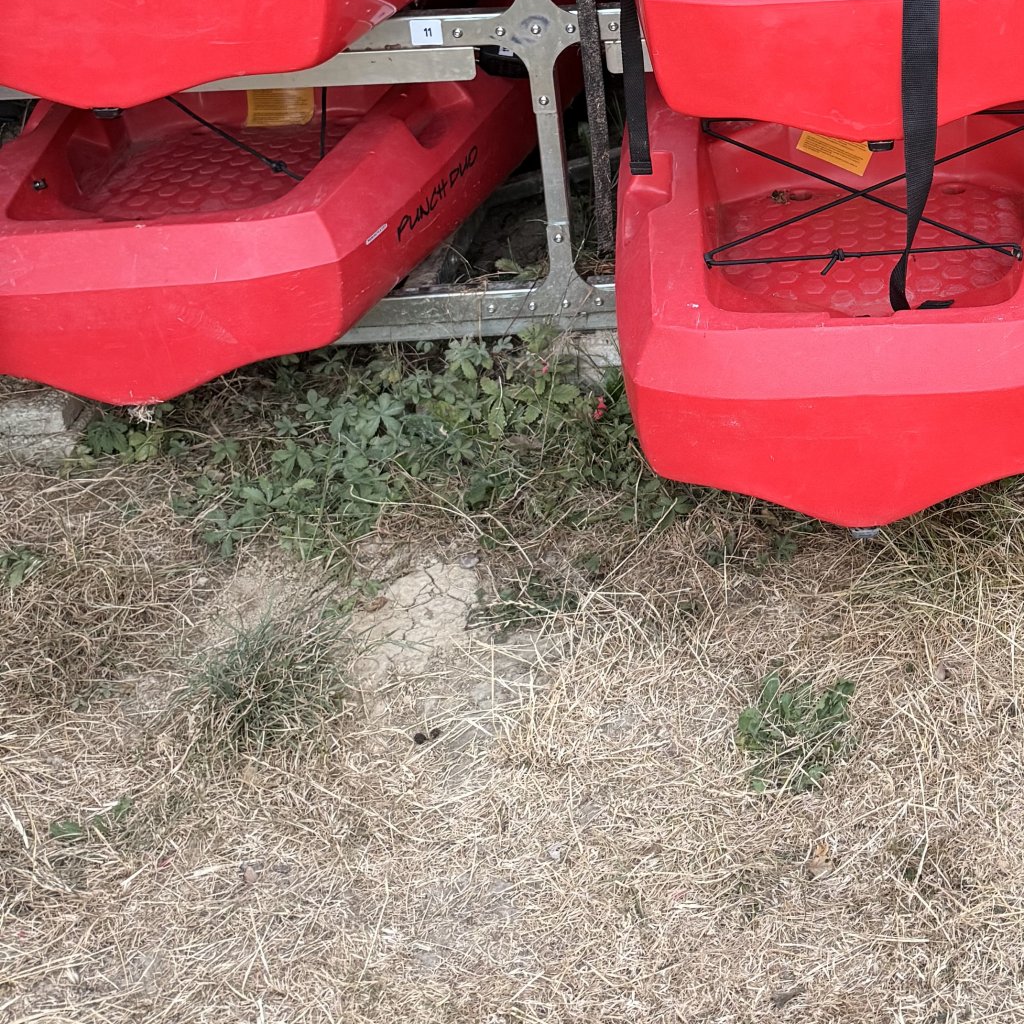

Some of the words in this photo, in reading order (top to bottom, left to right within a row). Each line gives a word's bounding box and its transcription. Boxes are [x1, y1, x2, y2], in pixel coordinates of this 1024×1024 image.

[423, 27, 433, 37] 11
[397, 179, 448, 242] PUNCH
[449, 144, 478, 189] DUO
